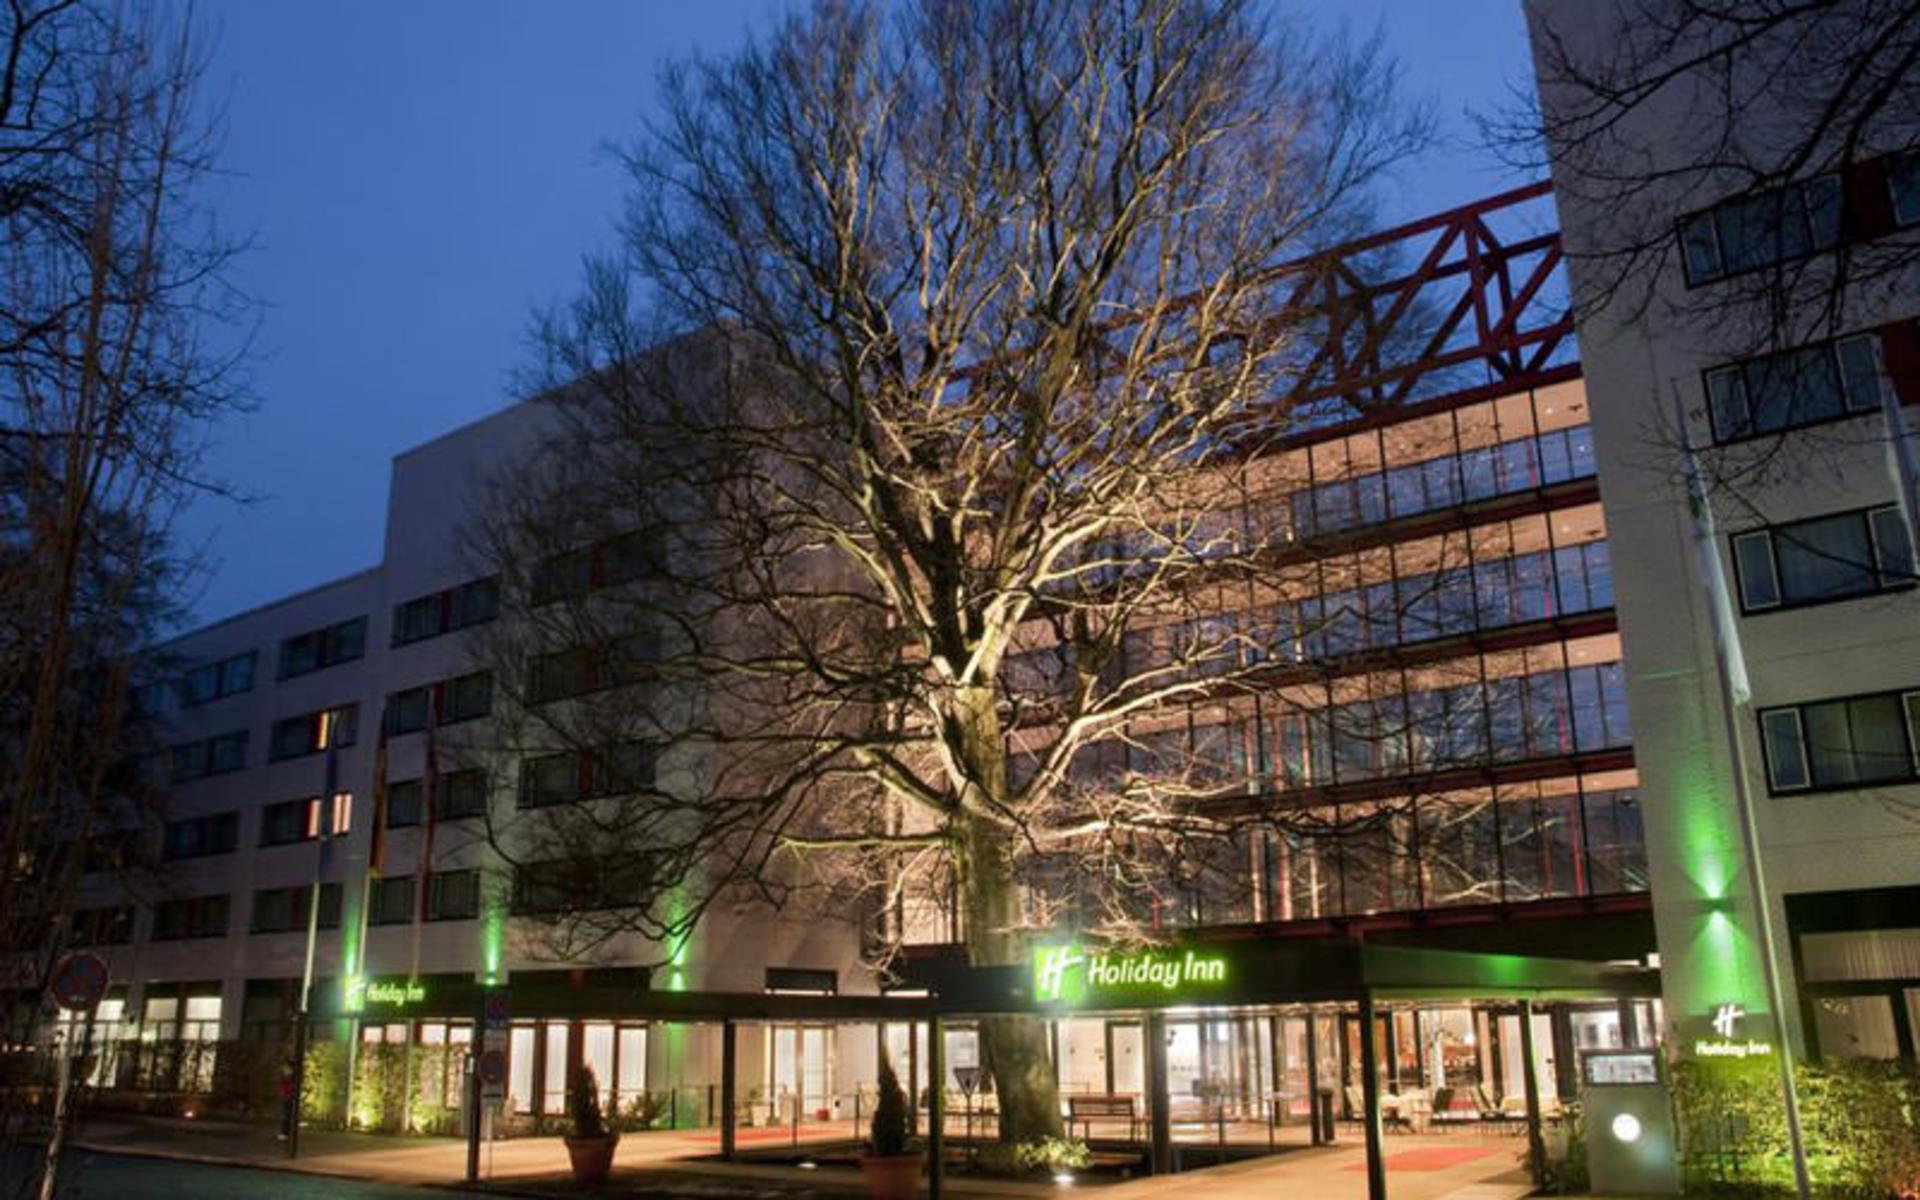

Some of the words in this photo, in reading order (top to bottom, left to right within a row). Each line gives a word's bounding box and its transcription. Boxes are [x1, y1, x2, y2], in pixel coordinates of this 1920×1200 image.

[1089, 956, 1180, 988] Holiday
[1184, 952, 1225, 981] Inn
[367, 982, 405, 1006] Holiday
[407, 983, 424, 1001] Inn
[1696, 1040, 1747, 1057] Holiday
[1749, 1040, 1772, 1055] Inn
